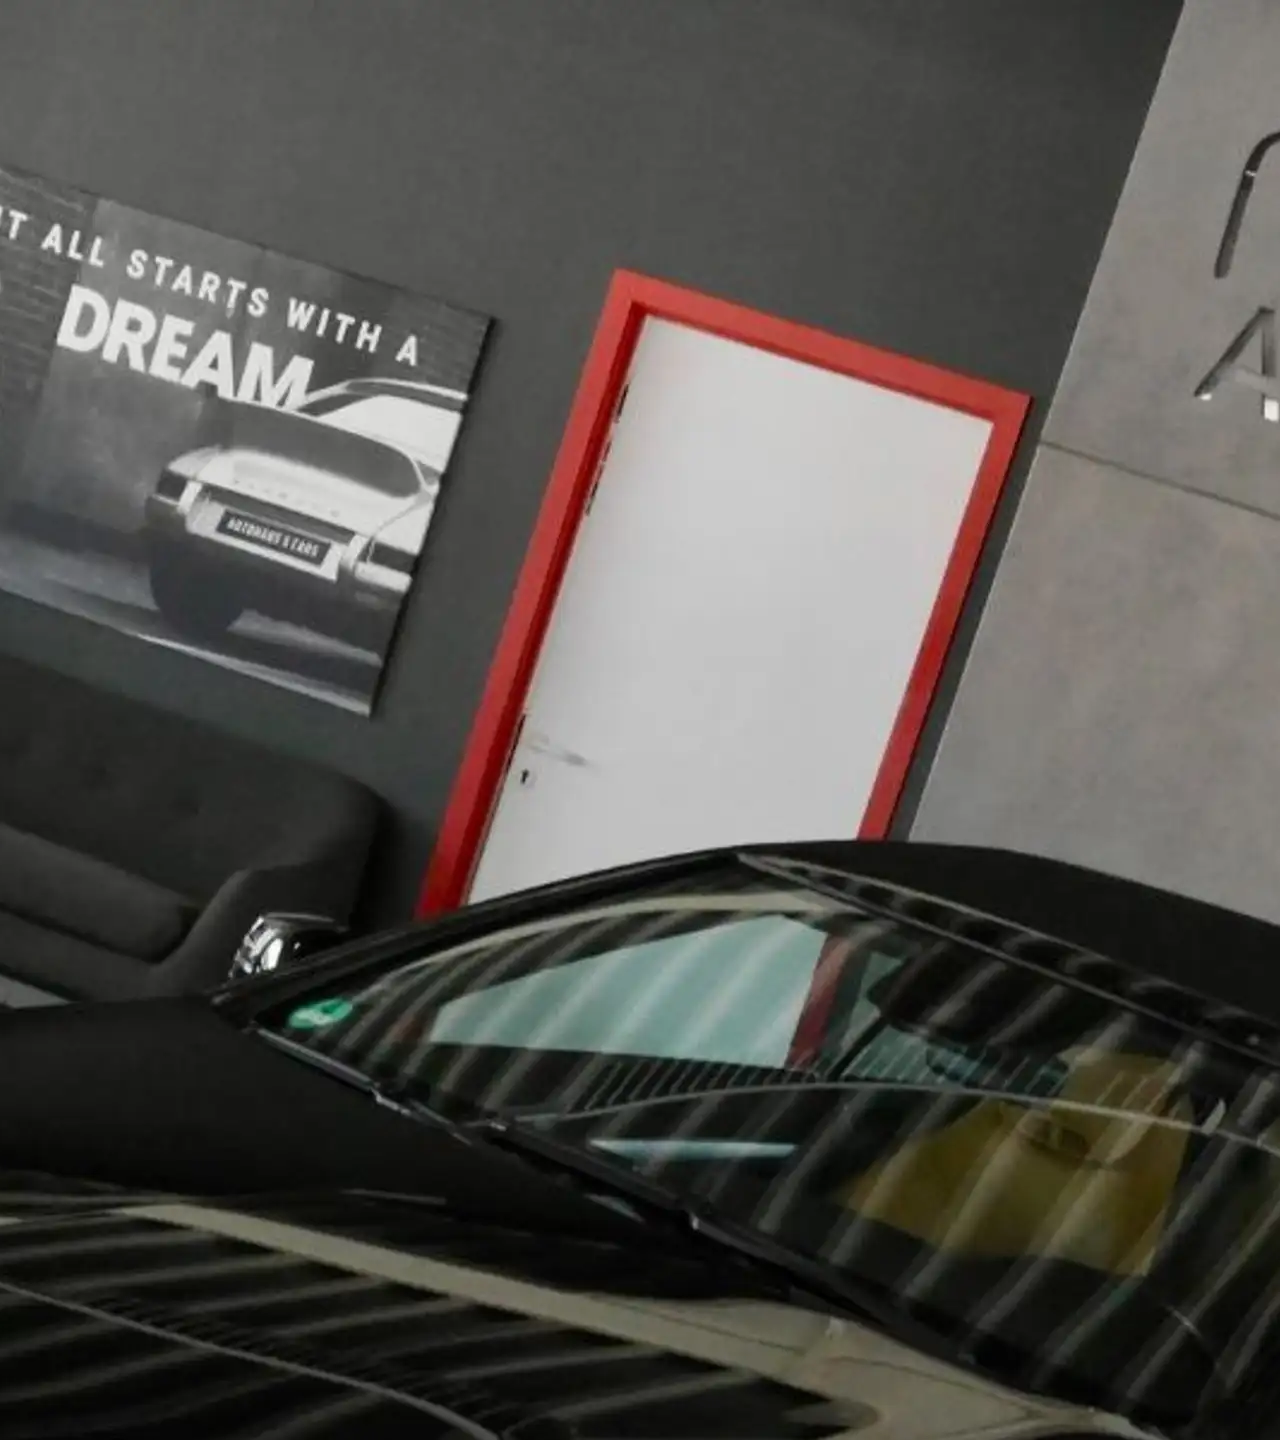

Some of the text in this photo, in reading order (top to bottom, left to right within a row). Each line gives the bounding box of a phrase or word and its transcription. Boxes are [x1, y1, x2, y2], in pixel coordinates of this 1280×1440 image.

[40, 223, 105, 268] ALL
[126, 248, 270, 320] STARTS
[286, 296, 383, 354] WITH
[394, 332, 418, 367] A
[56, 282, 315, 412] DREAM
